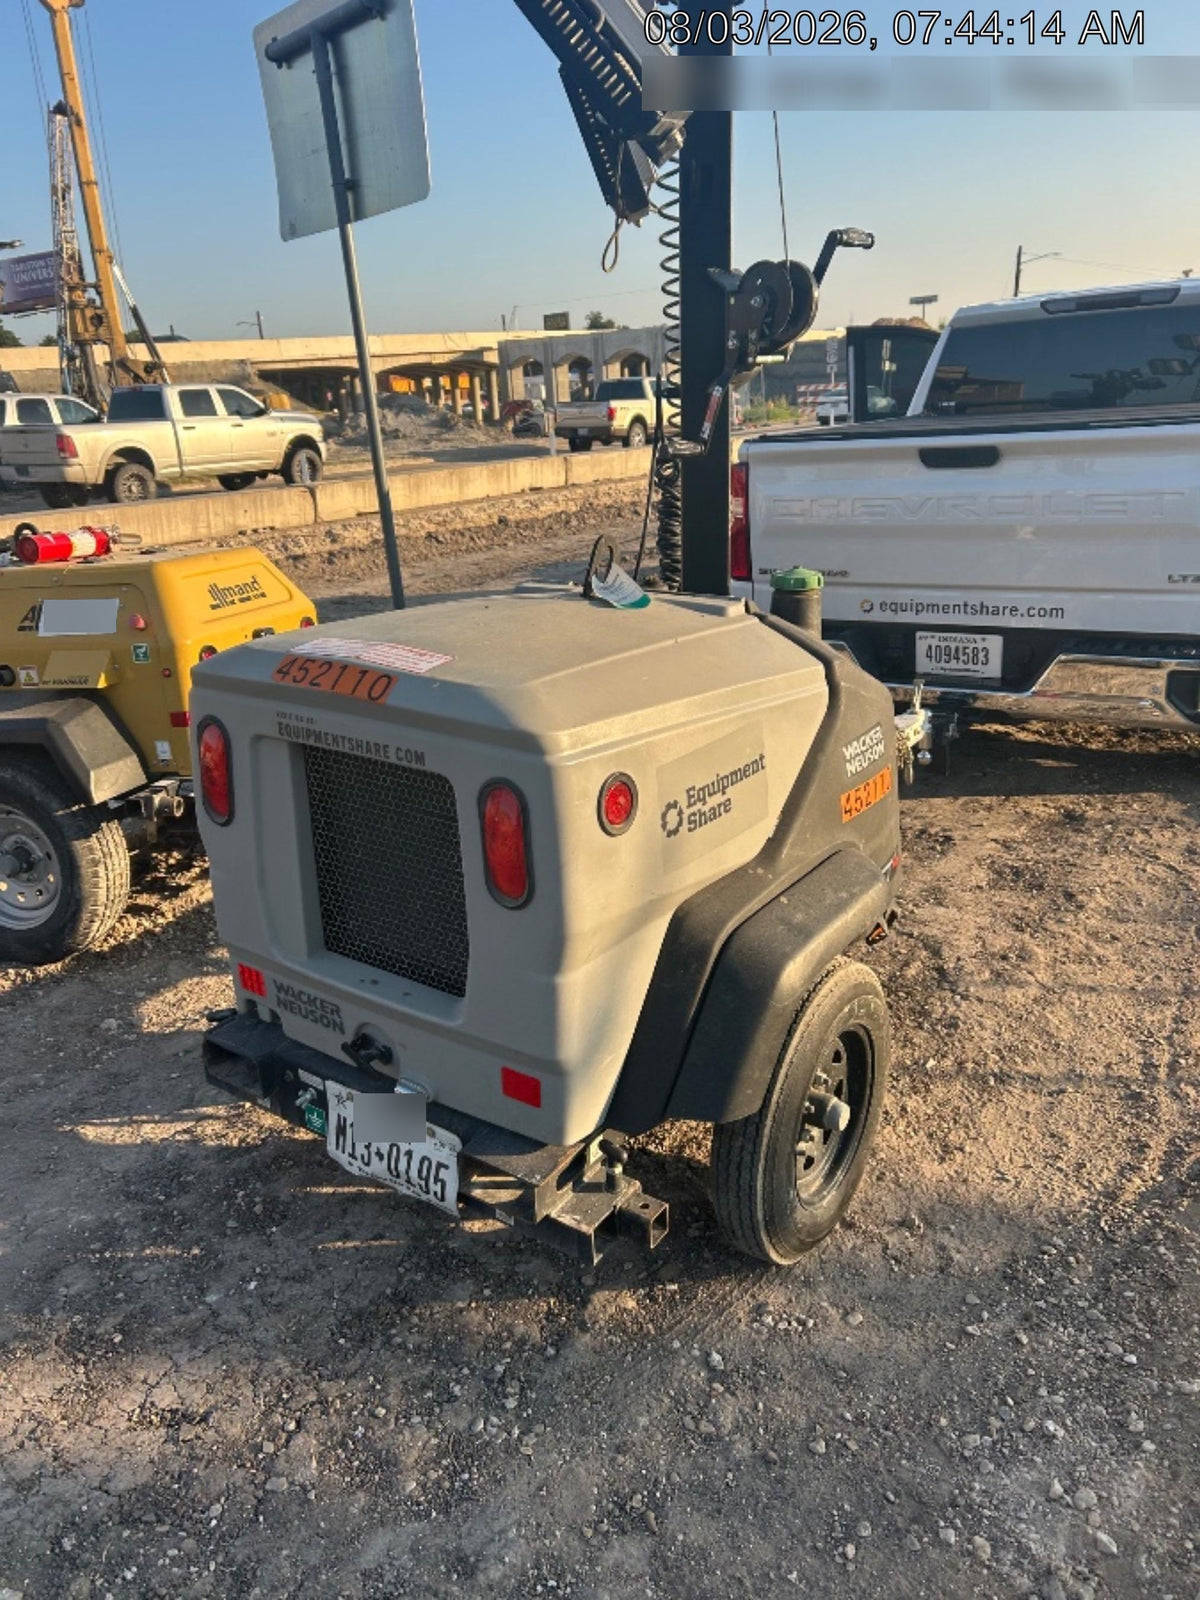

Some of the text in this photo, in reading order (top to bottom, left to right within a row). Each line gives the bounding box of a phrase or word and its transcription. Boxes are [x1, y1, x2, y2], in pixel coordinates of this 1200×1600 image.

[772, 491, 1185, 520] CHEVROLET
[879, 598, 1065, 619] equipmentshare.com
[925, 643, 990, 667] 4094583
[938, 634, 977, 645] INDIANA
[276, 656, 393, 702] 452110
[842, 725, 884, 760] WACKER
[845, 740, 885, 778] NEUSON
[685, 752, 767, 808] Equipment
[686, 796, 732, 833] Share
[272, 977, 343, 1020] WACKER
[276, 993, 346, 1036] NEUSON
